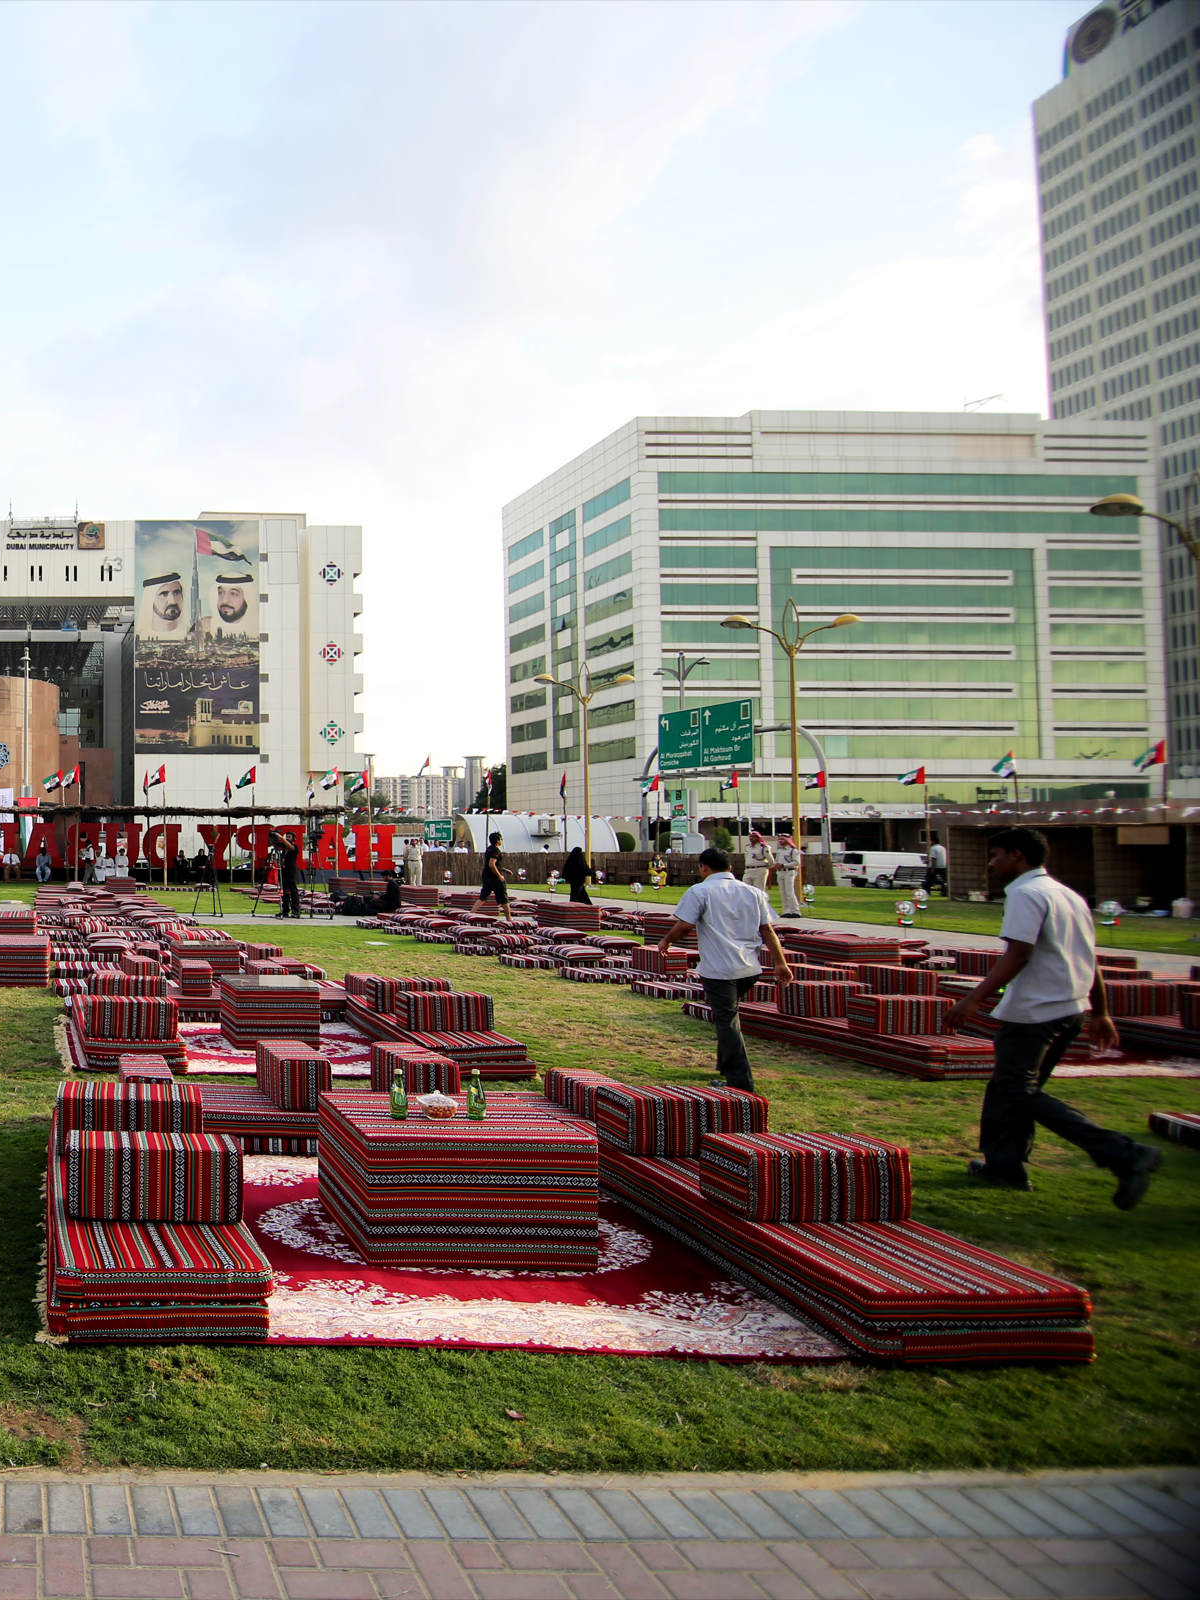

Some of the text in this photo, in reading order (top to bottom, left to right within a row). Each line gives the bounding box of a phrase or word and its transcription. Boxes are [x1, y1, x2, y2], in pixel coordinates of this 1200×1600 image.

[7, 530, 38, 540] دبي
[710, 745, 733, 754] Maktoum
[710, 754, 732, 762] Garhoud
